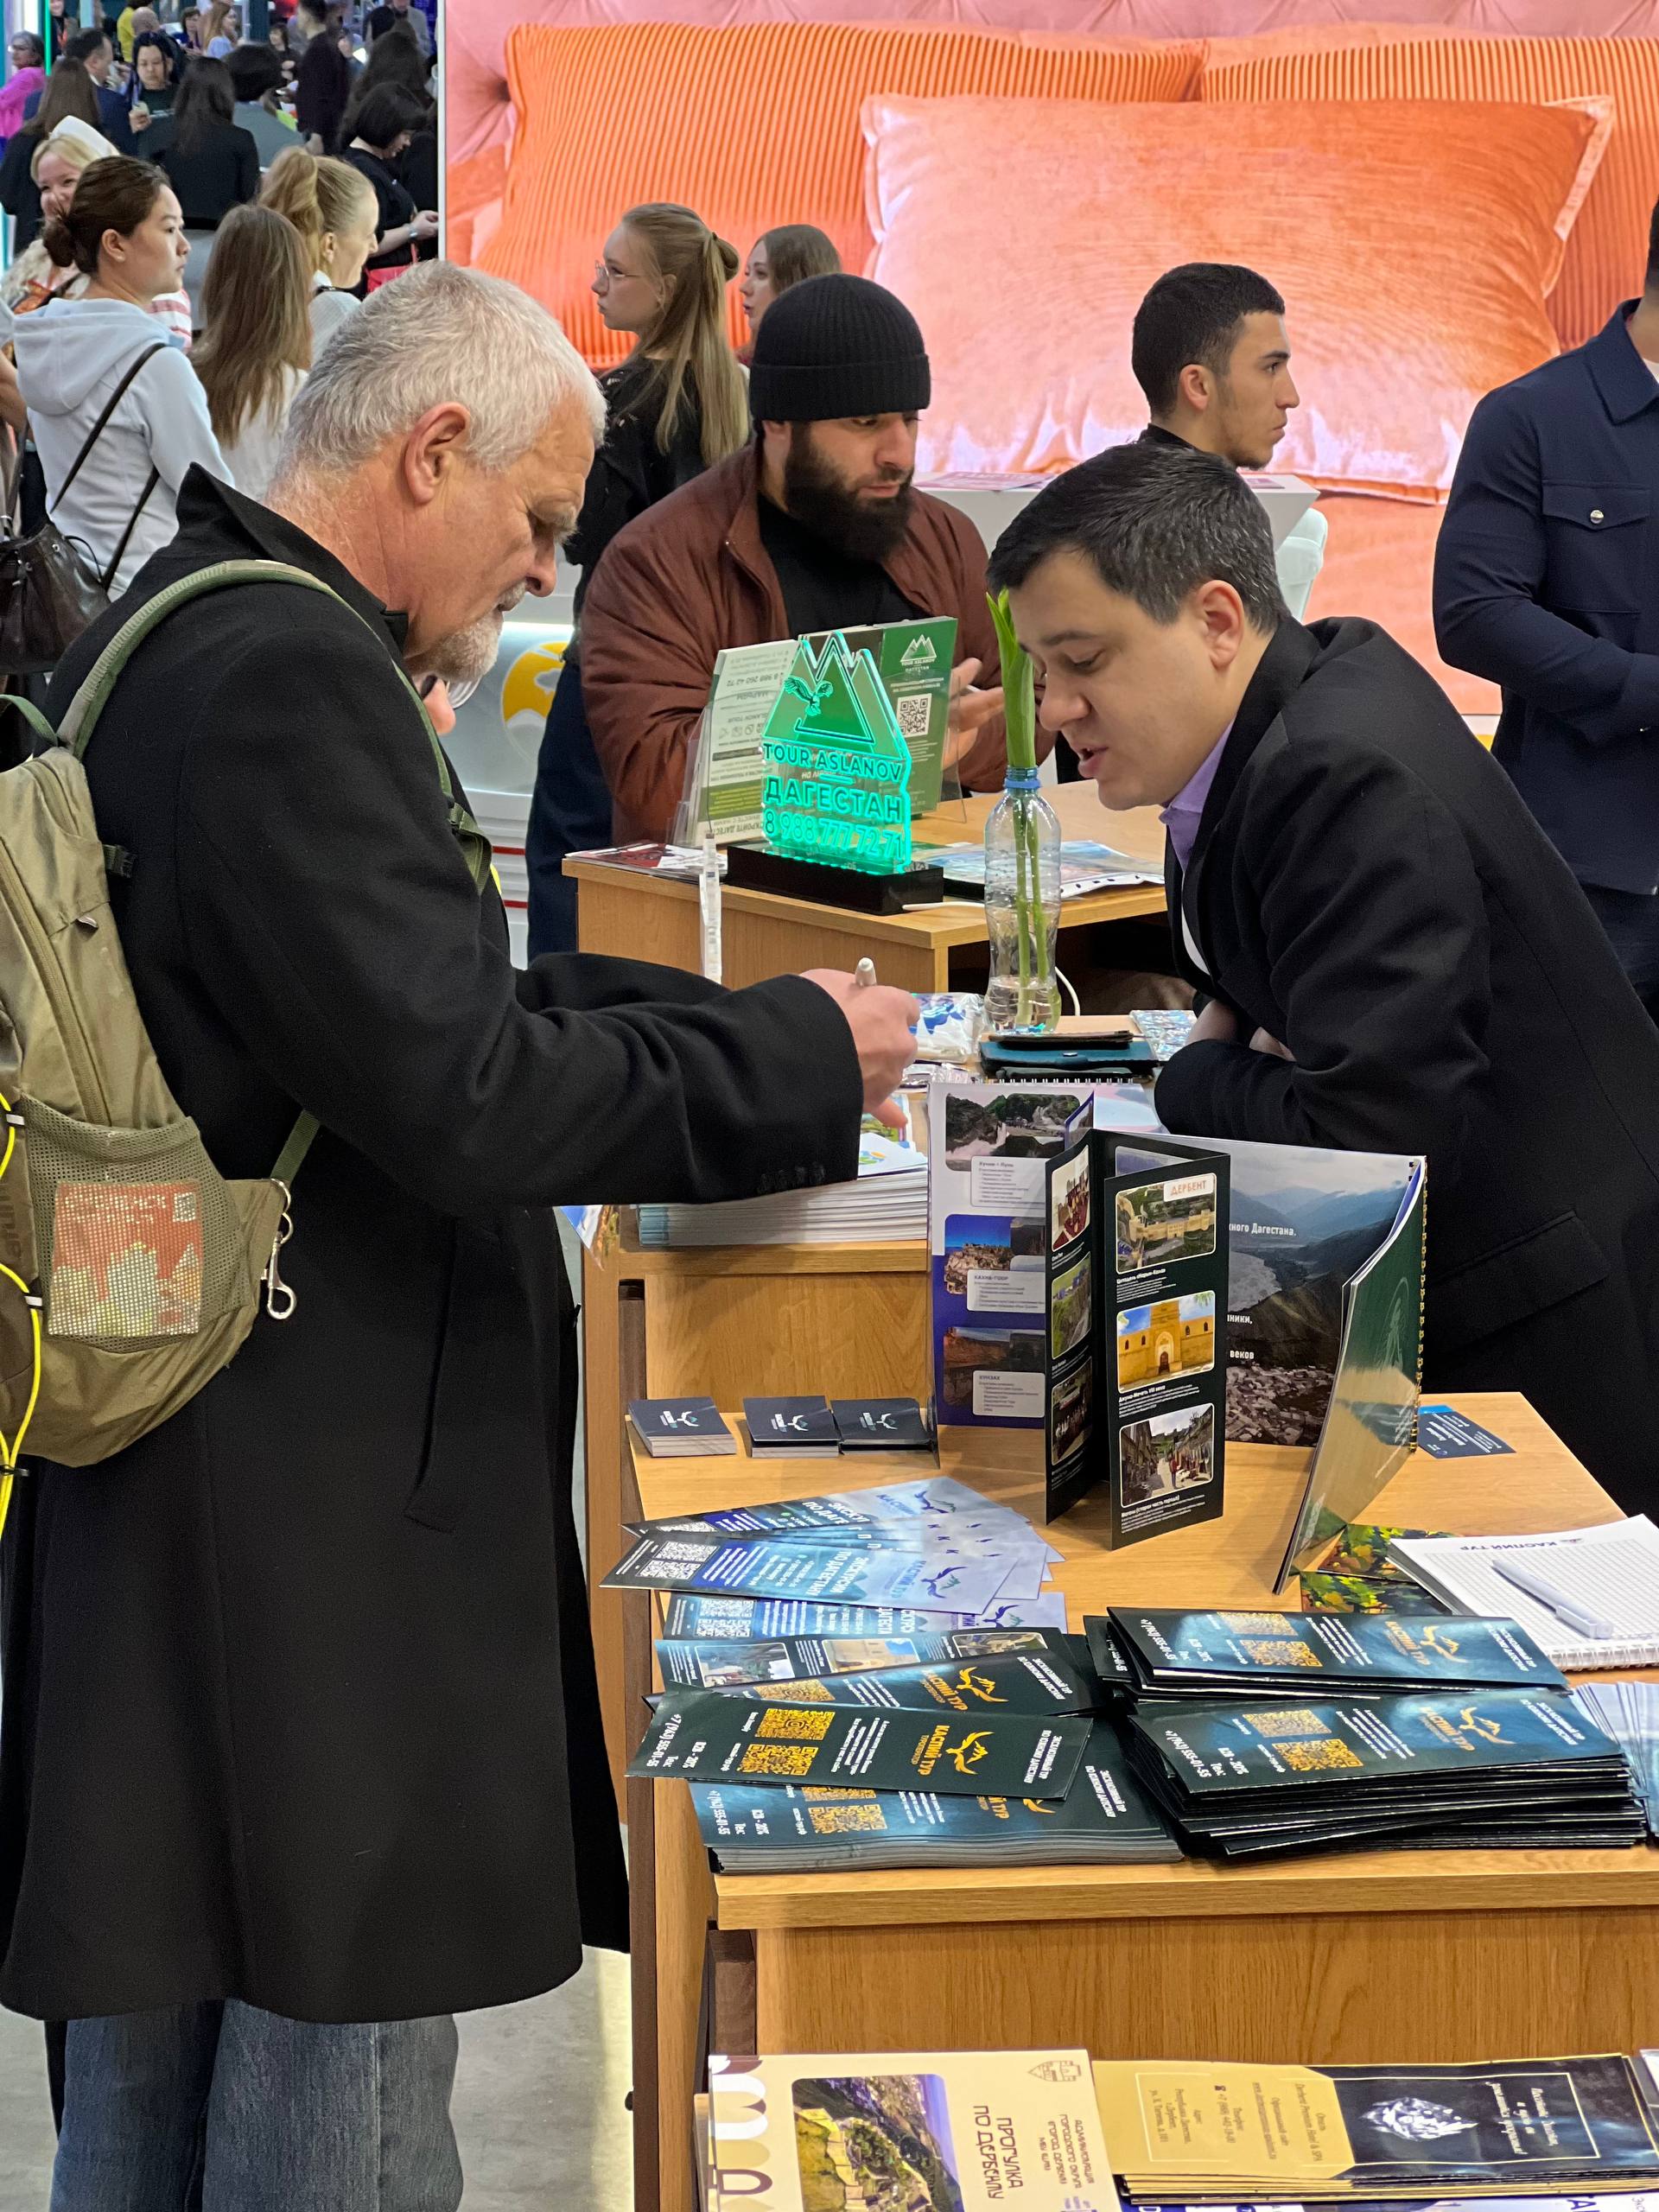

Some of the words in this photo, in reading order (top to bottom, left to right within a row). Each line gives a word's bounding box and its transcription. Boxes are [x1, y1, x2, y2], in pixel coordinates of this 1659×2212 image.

[763, 743, 810, 767] TOUR
[816, 750, 903, 782] ASLANOV
[765, 775, 902, 823] ДАГЕСТАН
[764, 808, 777, 836] 8
[780, 811, 817, 843] 988
[819, 817, 853, 850] 777
[855, 823, 880, 856] 72
[882, 829, 903, 861] 71
[1170, 1179, 1206, 1197] ДЕРБЕНТ
[1251, 1223, 1297, 1236] Дагестана.
[1230, 1350, 1255, 1360] веков
[802, 1501, 823, 1510] ПО
[834, 1551, 851, 1560] ПО
[1491, 1541, 1557, 1551] КАСПИЙ
[805, 1560, 842, 1595] ДАГЕСТАНУ
[830, 1557, 868, 1592] ЭКСКУРСИИ
[898, 1560, 926, 1586] КАСПИЙ
[891, 1586, 907, 1598] ТУР
[1153, 1637, 1179, 1660] 555-01-55
[1385, 1621, 1420, 1649] КАСПИЙ
[1411, 1650, 1432, 1665] ТУР
[941, 1696, 968, 1710] ТУР
[670, 1713, 681, 1722] +7
[1418, 1706, 1460, 1735] КАСПИЙ
[1452, 1736, 1474, 1751] ТУР
[659, 1722, 678, 1739] (963)
[925, 1725, 949, 1758] КАСПИЙ
[646, 1739, 670, 1766] 555-01-55
[691, 1741, 706, 1752] B2B
[1033, 1737, 1048, 1758] ЮЖНОМУ
[1041, 1735, 1061, 1770] ЭКСКЛЮЗИВНЫЙ
[1166, 1736, 1189, 1749] (963)
[1181, 1749, 1211, 1777] 555-01-55
[662, 1755, 678, 1767] Тел:
[682, 1756, 698, 1768] 20%
[918, 1759, 935, 1775] ТУР
[1024, 1758, 1039, 1783] ДАГЕСТАНУ
[1210, 1762, 1225, 1776] Тел:
[1217, 1747, 1234, 1757] B2B
[1230, 1761, 1249, 1774] 20%
[992, 1803, 1009, 1818] ТУР
[1096, 1793, 1116, 1817] ДАГЕСТАНУ
[713, 1808, 730, 1834] 555-01-55
[734, 1822, 746, 1834] Тел:
[754, 1822, 769, 1834] 20%
[973, 2105, 990, 2126] ПО
[1294, 2083, 1306, 2104] Derbent
[1300, 2105, 1312, 2128] Premium
[1311, 2150, 1322, 2161] SPA
[997, 2117, 1022, 2188] ПРОГУЛКА
[1060, 2113, 1076, 2162] ГОРОДСКОГО
[1069, 2164, 1081, 2188] ОКРУГА
[1075, 2120, 1094, 2183] АДМИНИСТРАЦИЯ
[976, 2131, 1002, 2198] ДЕРБЕНТУ
